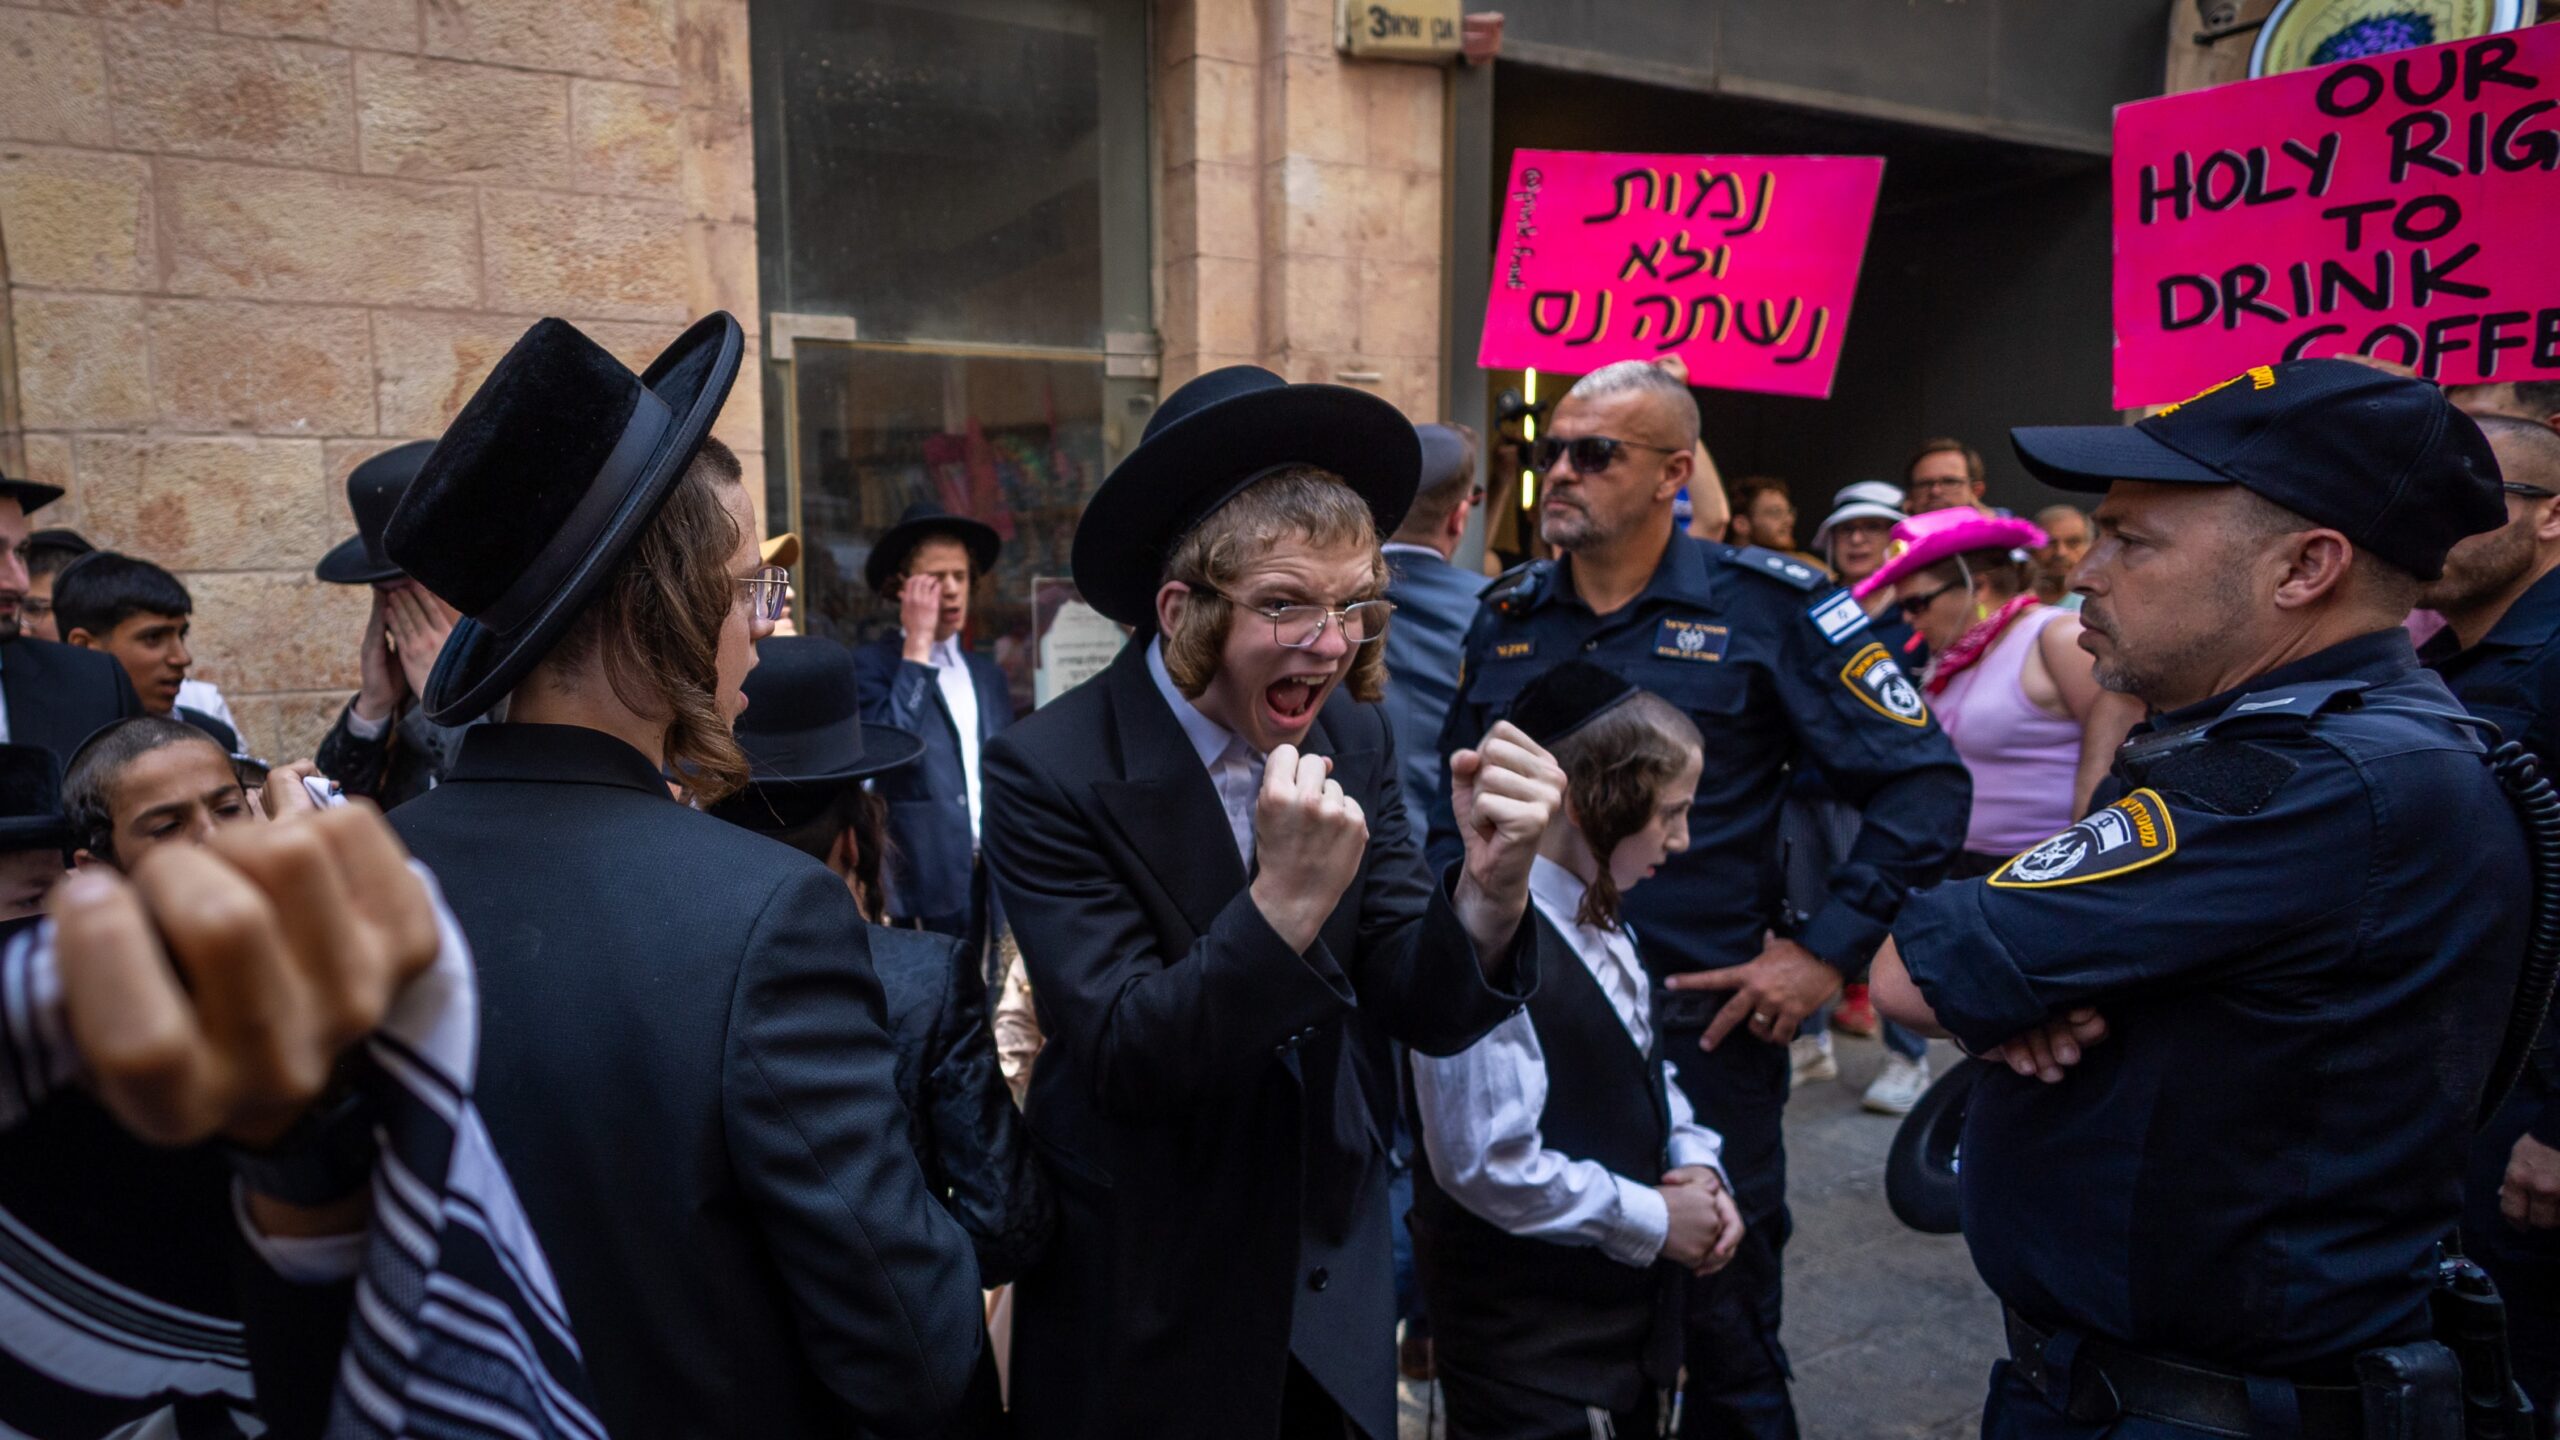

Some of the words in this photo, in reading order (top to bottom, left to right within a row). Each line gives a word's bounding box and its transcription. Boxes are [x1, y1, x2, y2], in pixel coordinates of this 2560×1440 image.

[1367, 5, 1388, 39] 3
[2315, 37, 2540, 117] OUR
[2139, 132, 2341, 225] HOLY
[2386, 98, 2560, 184] RIG
[1583, 168, 1775, 237] נמות
[2321, 194, 2462, 252] TO
[1618, 230, 1731, 283] ולא
[2158, 243, 2491, 330] DRINK
[1530, 289, 1613, 347] נס
[1633, 293, 1829, 366] נשתה
